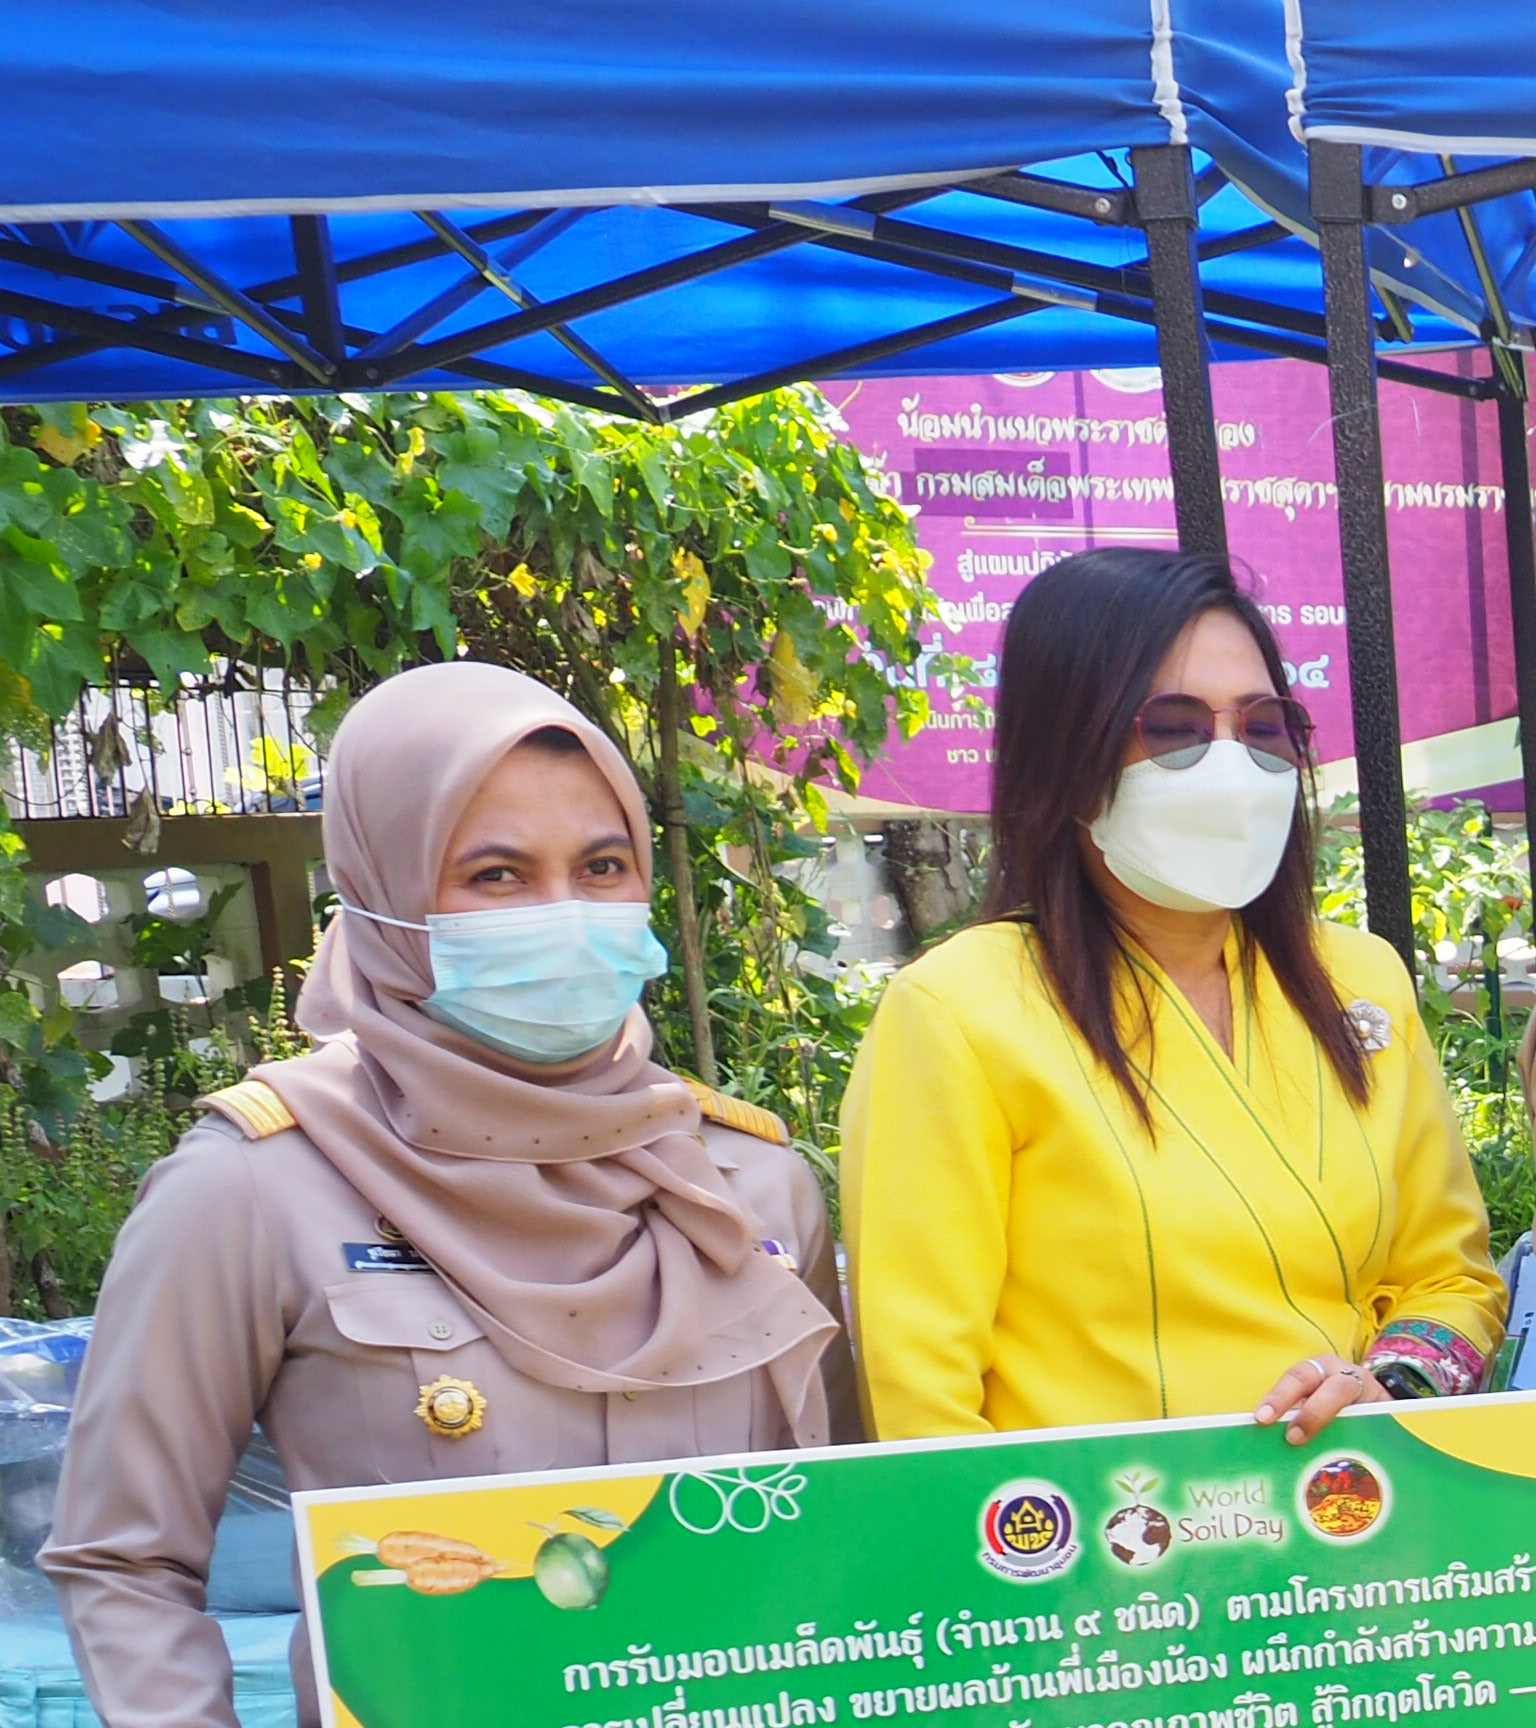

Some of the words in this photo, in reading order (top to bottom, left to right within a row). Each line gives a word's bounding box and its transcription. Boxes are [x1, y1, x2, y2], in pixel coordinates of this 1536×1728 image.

[1187, 1479, 1266, 1509] World
[1177, 1515, 1228, 1543] Soil
[1233, 1512, 1284, 1543] Day
[563, 1611, 925, 1694] การรับมอบเมล็ดพันธุ์
[936, 1609, 1065, 1656] (จำนวน
[1073, 1609, 1102, 1638] ๙
[1113, 1590, 1201, 1633] ชนิด)
[848, 1641, 1228, 1719] ขยายผลบ้านพี่เมืองน้อง
